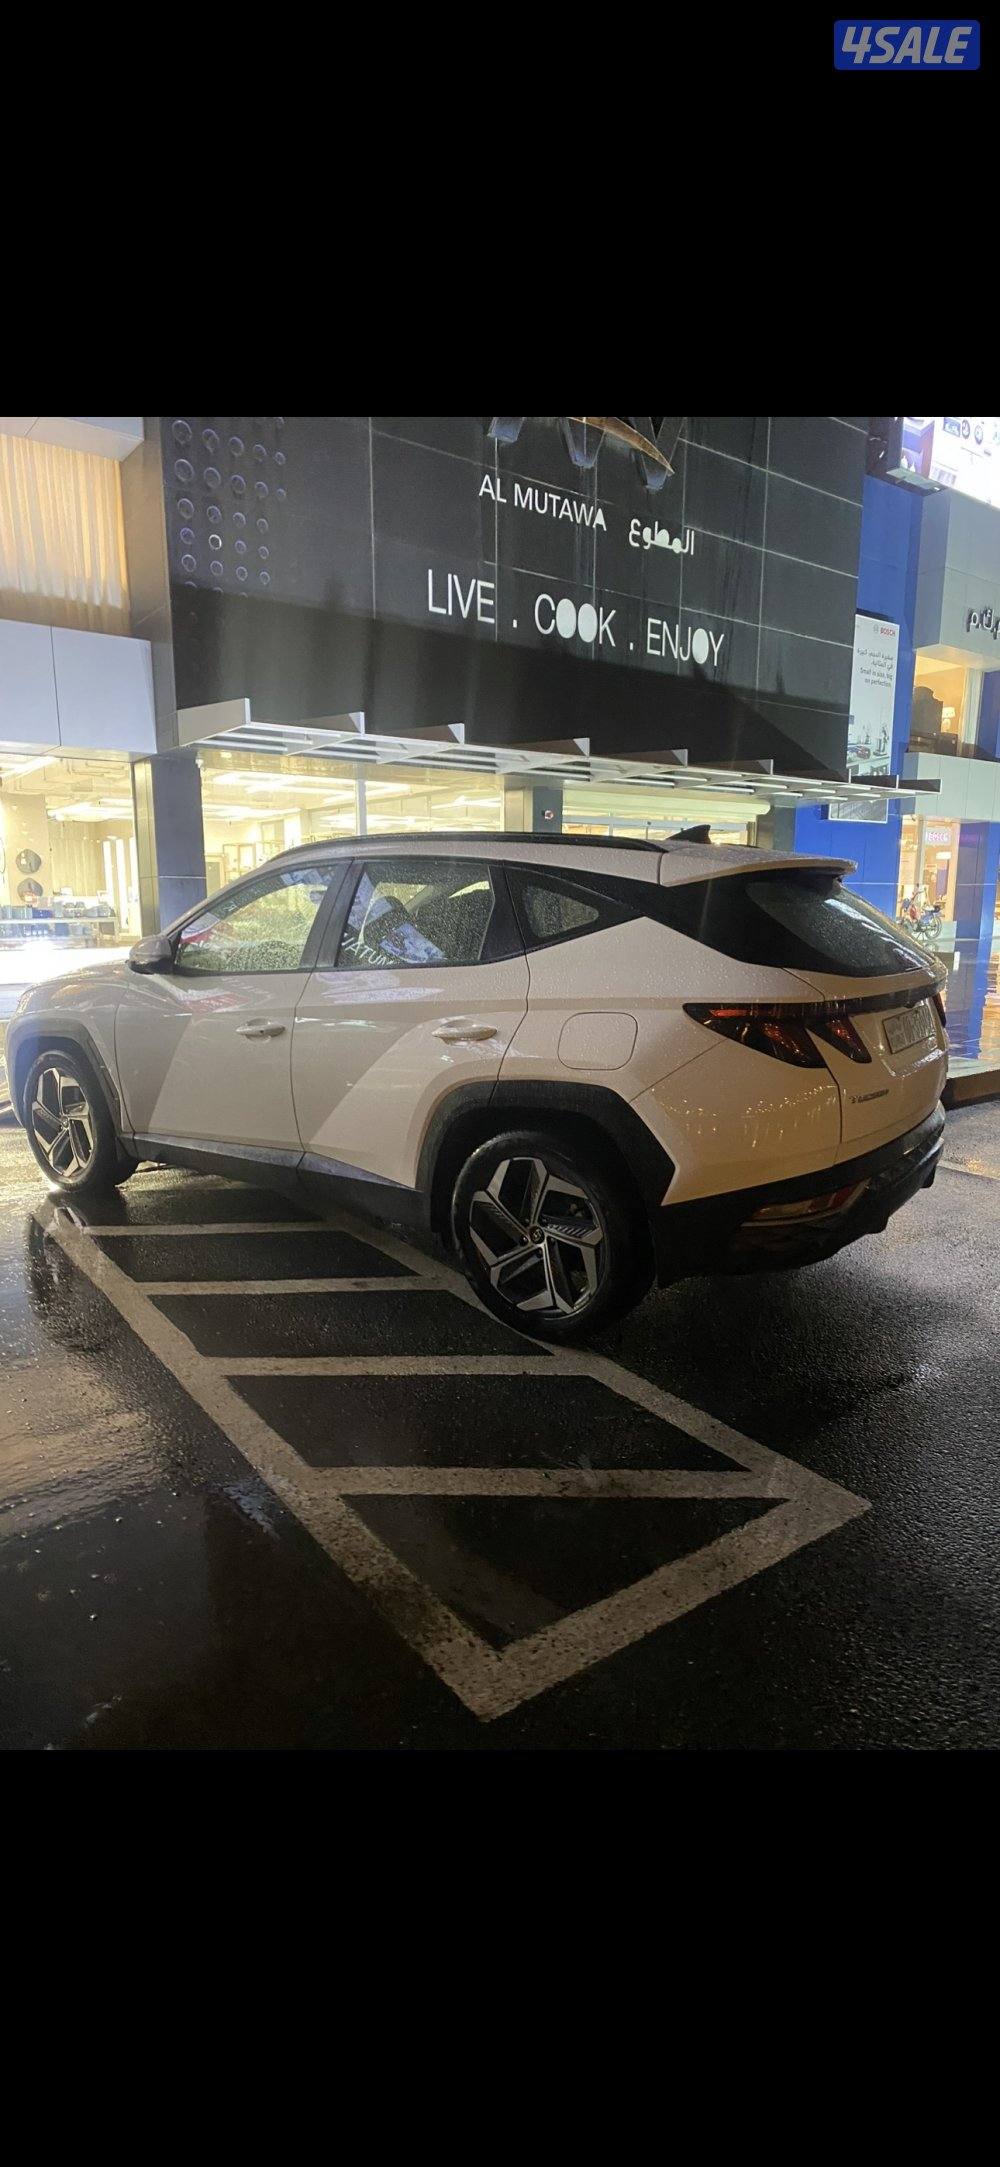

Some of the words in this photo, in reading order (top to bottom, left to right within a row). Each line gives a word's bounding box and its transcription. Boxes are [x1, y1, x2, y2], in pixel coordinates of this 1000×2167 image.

[478, 474, 507, 503] AL
[514, 482, 607, 532] MUTAWA
[628, 518, 695, 555] المطوع
[428, 568, 495, 624] LIVE
[534, 593, 617, 648] COOK
[646, 617, 725, 666] ENJOY
[879, 627, 896, 637] BOSCH
